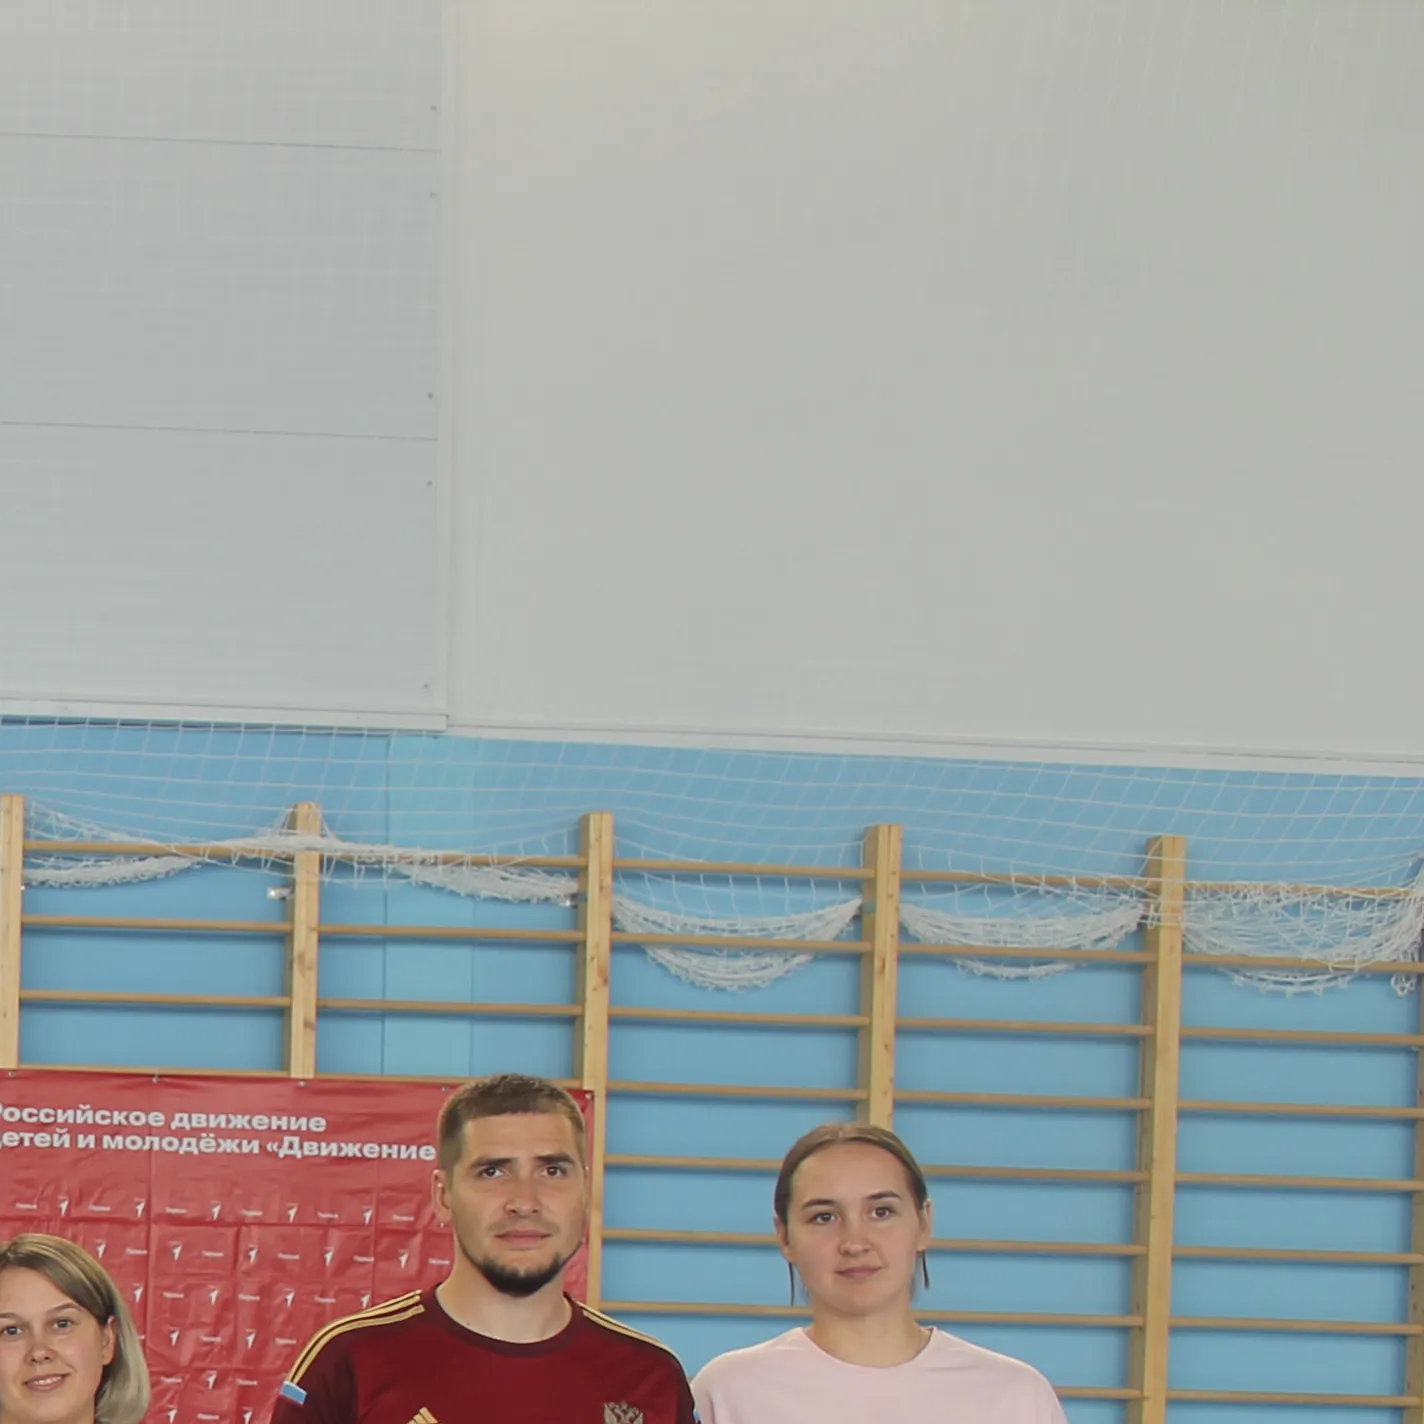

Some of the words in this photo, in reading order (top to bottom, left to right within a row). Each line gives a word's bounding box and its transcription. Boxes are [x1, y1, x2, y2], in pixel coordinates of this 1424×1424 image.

[170, 1111, 327, 1132] движение
[77, 1135, 96, 1148] и
[102, 1133, 260, 1155] молодёжи
[266, 1136, 437, 1161] «Движение
